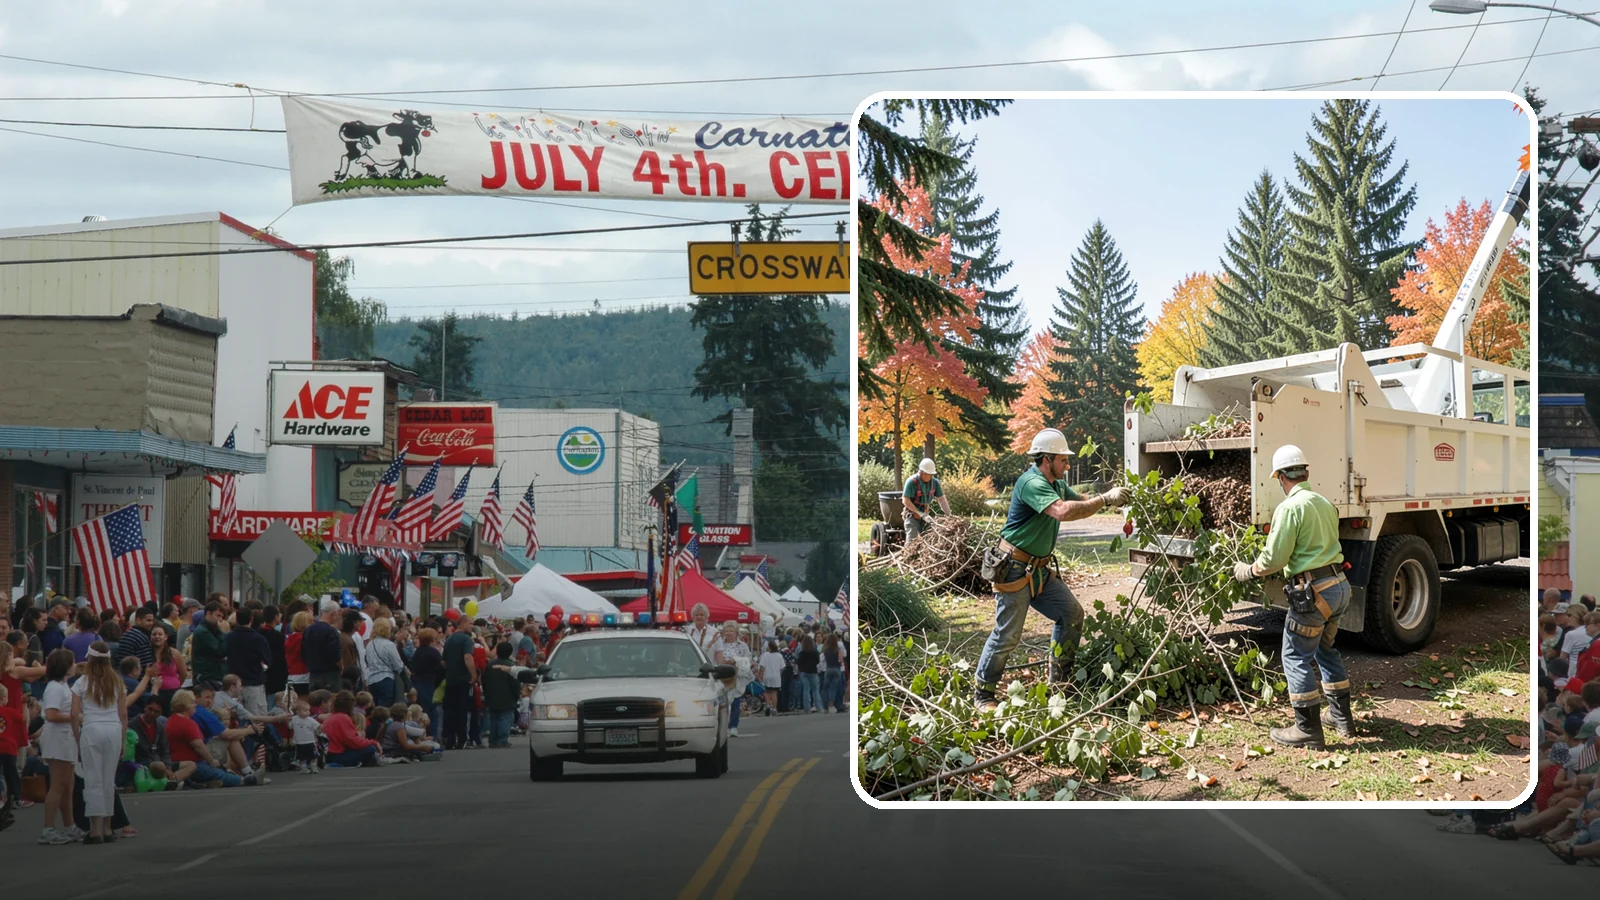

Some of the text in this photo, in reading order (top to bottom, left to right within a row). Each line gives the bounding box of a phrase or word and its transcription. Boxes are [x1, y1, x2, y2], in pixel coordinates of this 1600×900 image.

[481, 141, 605, 193] JULY
[632, 150, 746, 197] 4th.
[697, 254, 850, 279] CROSSWA
[283, 380, 373, 420] ACE
[406, 409, 452, 422] CEDAR
[284, 421, 370, 436] Hardware
[416, 428, 476, 447] Coca-Cola
[353, 467, 387, 481] Simpl
[83, 484, 155, 495] St. Vincent de Paul
[212, 515, 330, 536] HARDARE
[688, 526, 742, 535] CRNATION
[699, 535, 730, 543] GLASS
